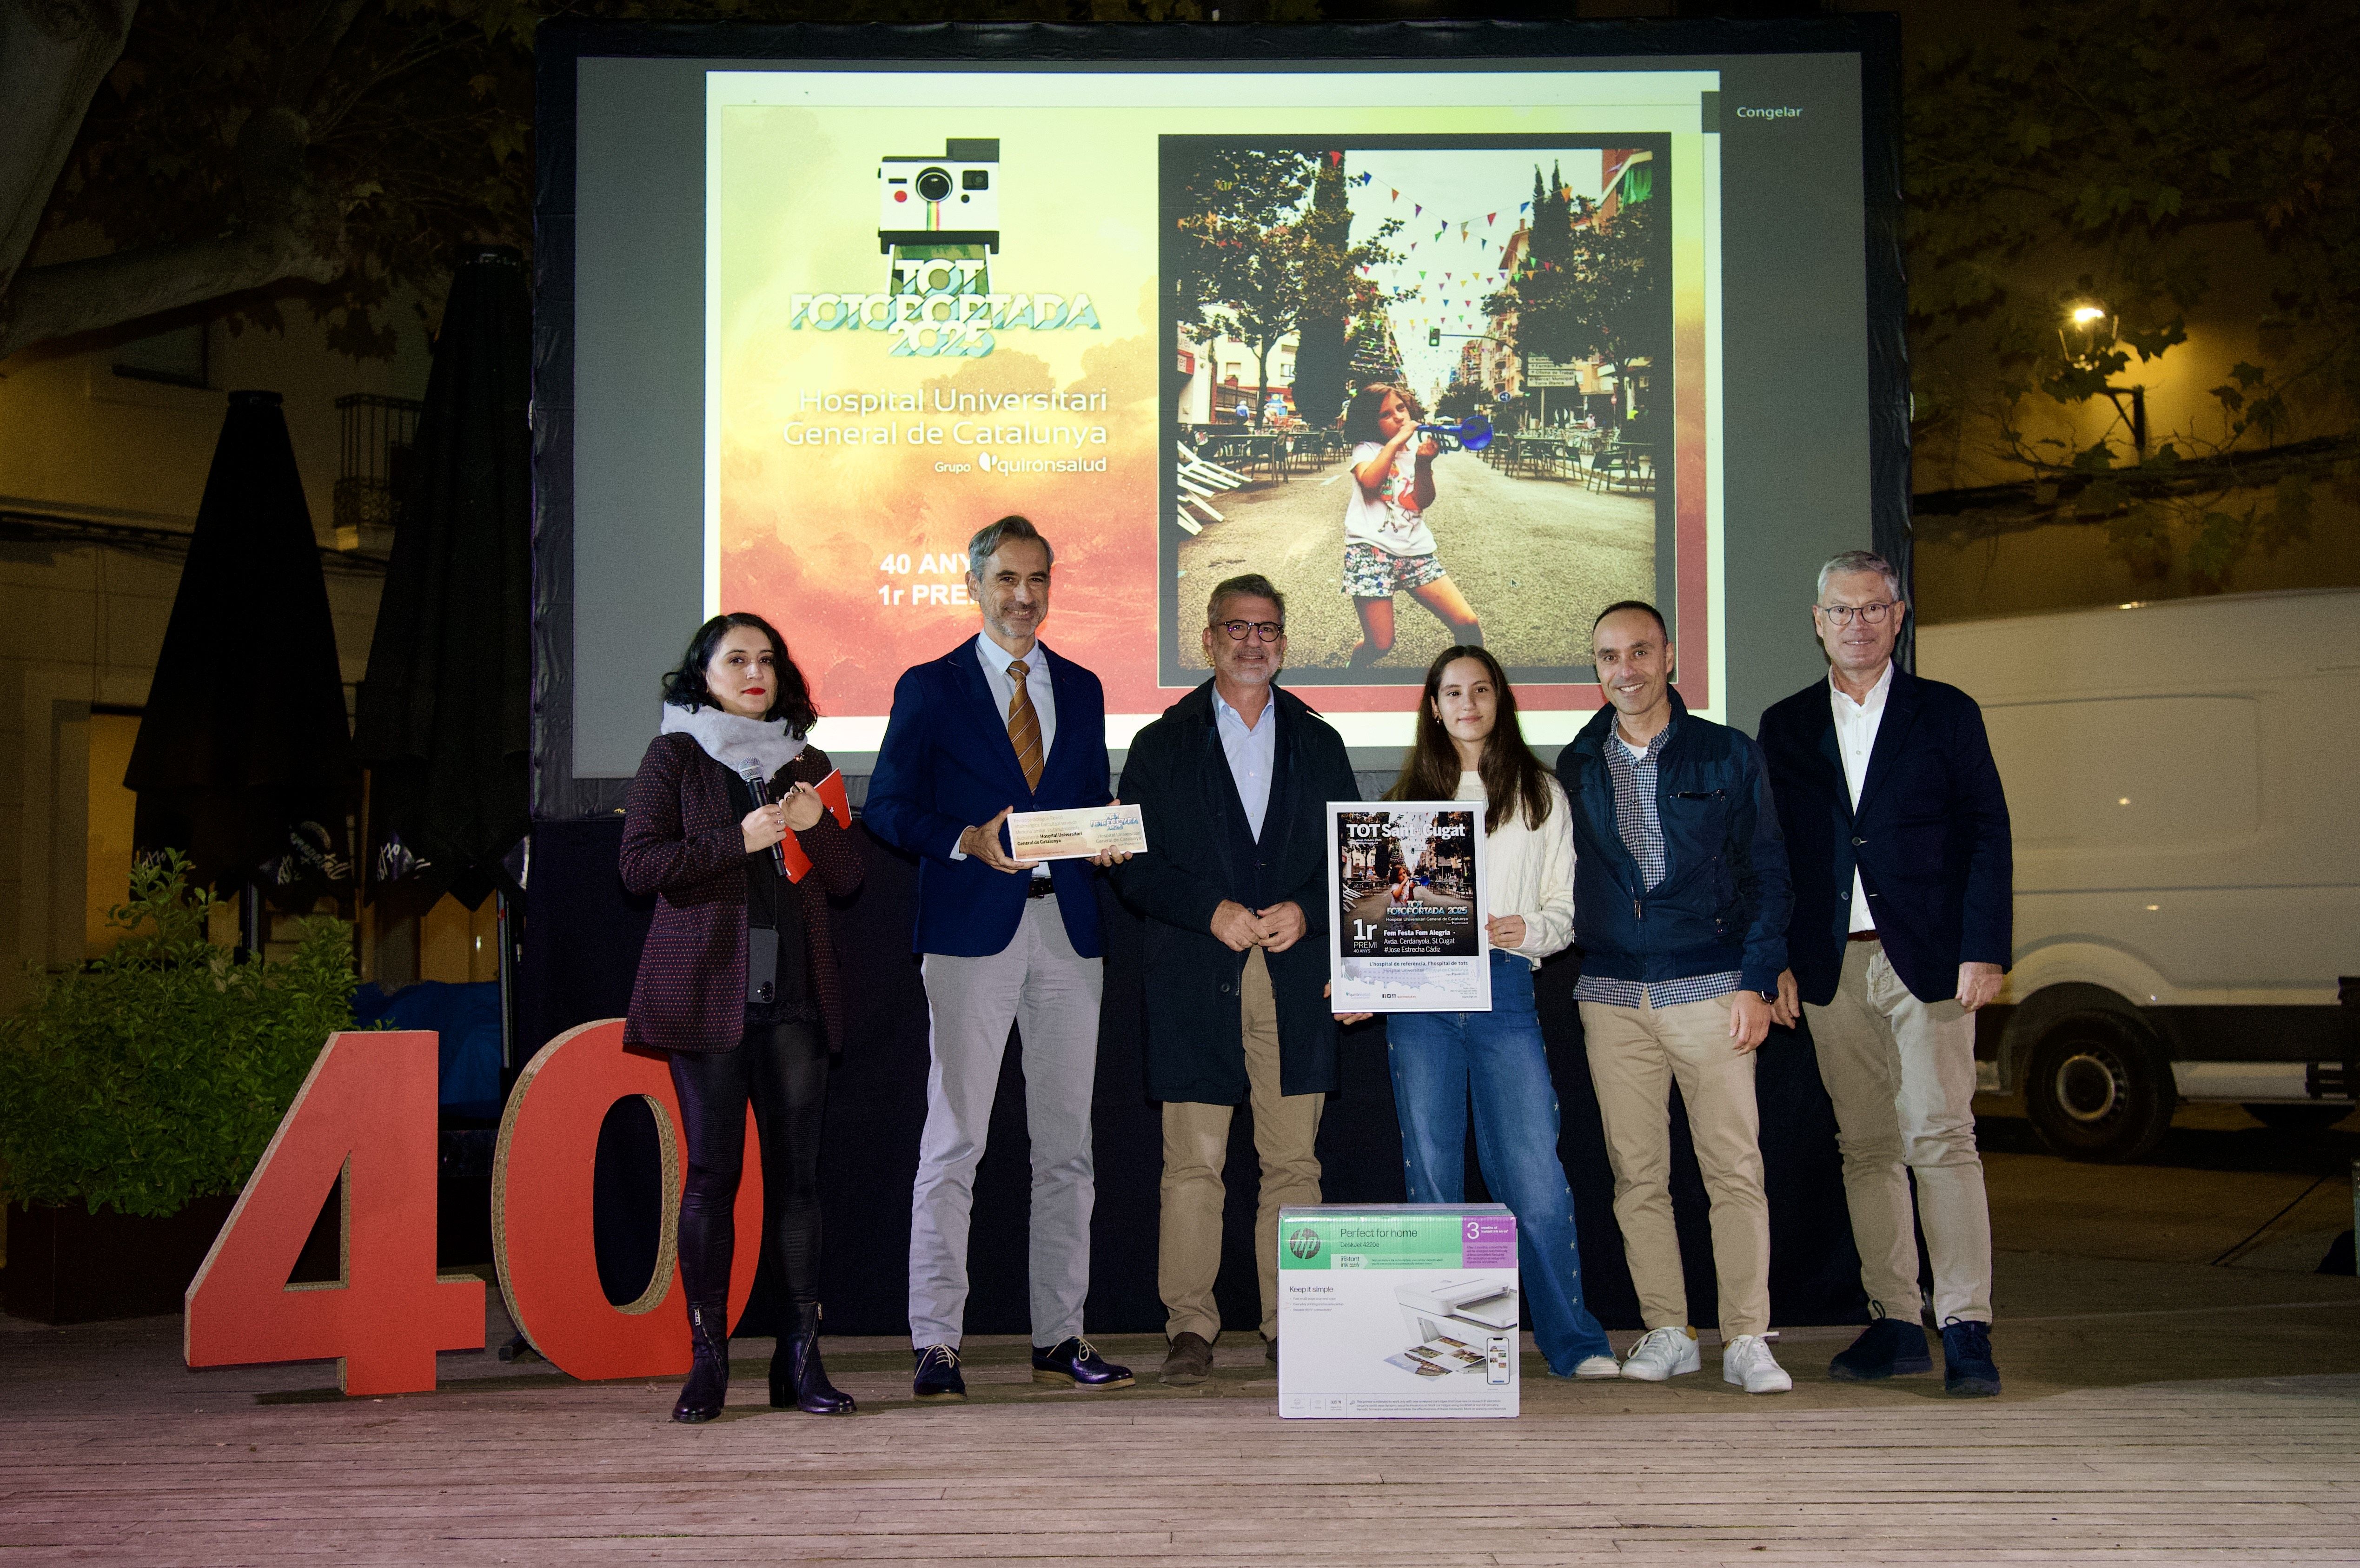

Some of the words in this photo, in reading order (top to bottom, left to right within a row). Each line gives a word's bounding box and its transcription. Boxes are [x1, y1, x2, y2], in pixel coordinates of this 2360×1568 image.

[1736, 106, 1803, 120] Congelar
[895, 258, 986, 295] TOT
[790, 293, 1101, 331] FOTOPORTADA
[887, 318, 995, 357] 2025
[800, 388, 924, 417] Hospital
[934, 387, 1107, 411] Universitari
[783, 421, 897, 445] General
[907, 421, 944, 445] de
[953, 421, 1107, 450] Catalunya
[934, 461, 971, 475] Grupo
[880, 553, 912, 575] 40
[917, 553, 971, 575] ANY
[878, 584, 905, 605] 1r
[911, 584, 980, 605] PRE
[1346, 823, 1381, 838] TOT
[1381, 823, 1416, 838] Sant
[1422, 823, 1465, 840] Cugat
[1386, 906, 1445, 915] FOTOPORTADA
[1447, 906, 1468, 915] 2025
[1406, 900, 1424, 908] TOT
[1353, 918, 1378, 941] 1r
[184, 1018, 764, 1395] 40
[1340, 1228, 1374, 1237] Perfect
[1377, 1228, 1389, 1237] for
[1391, 1228, 1418, 1237] home
[1466, 1221, 1479, 1240] 3
[1290, 1228, 1321, 1260] hp
